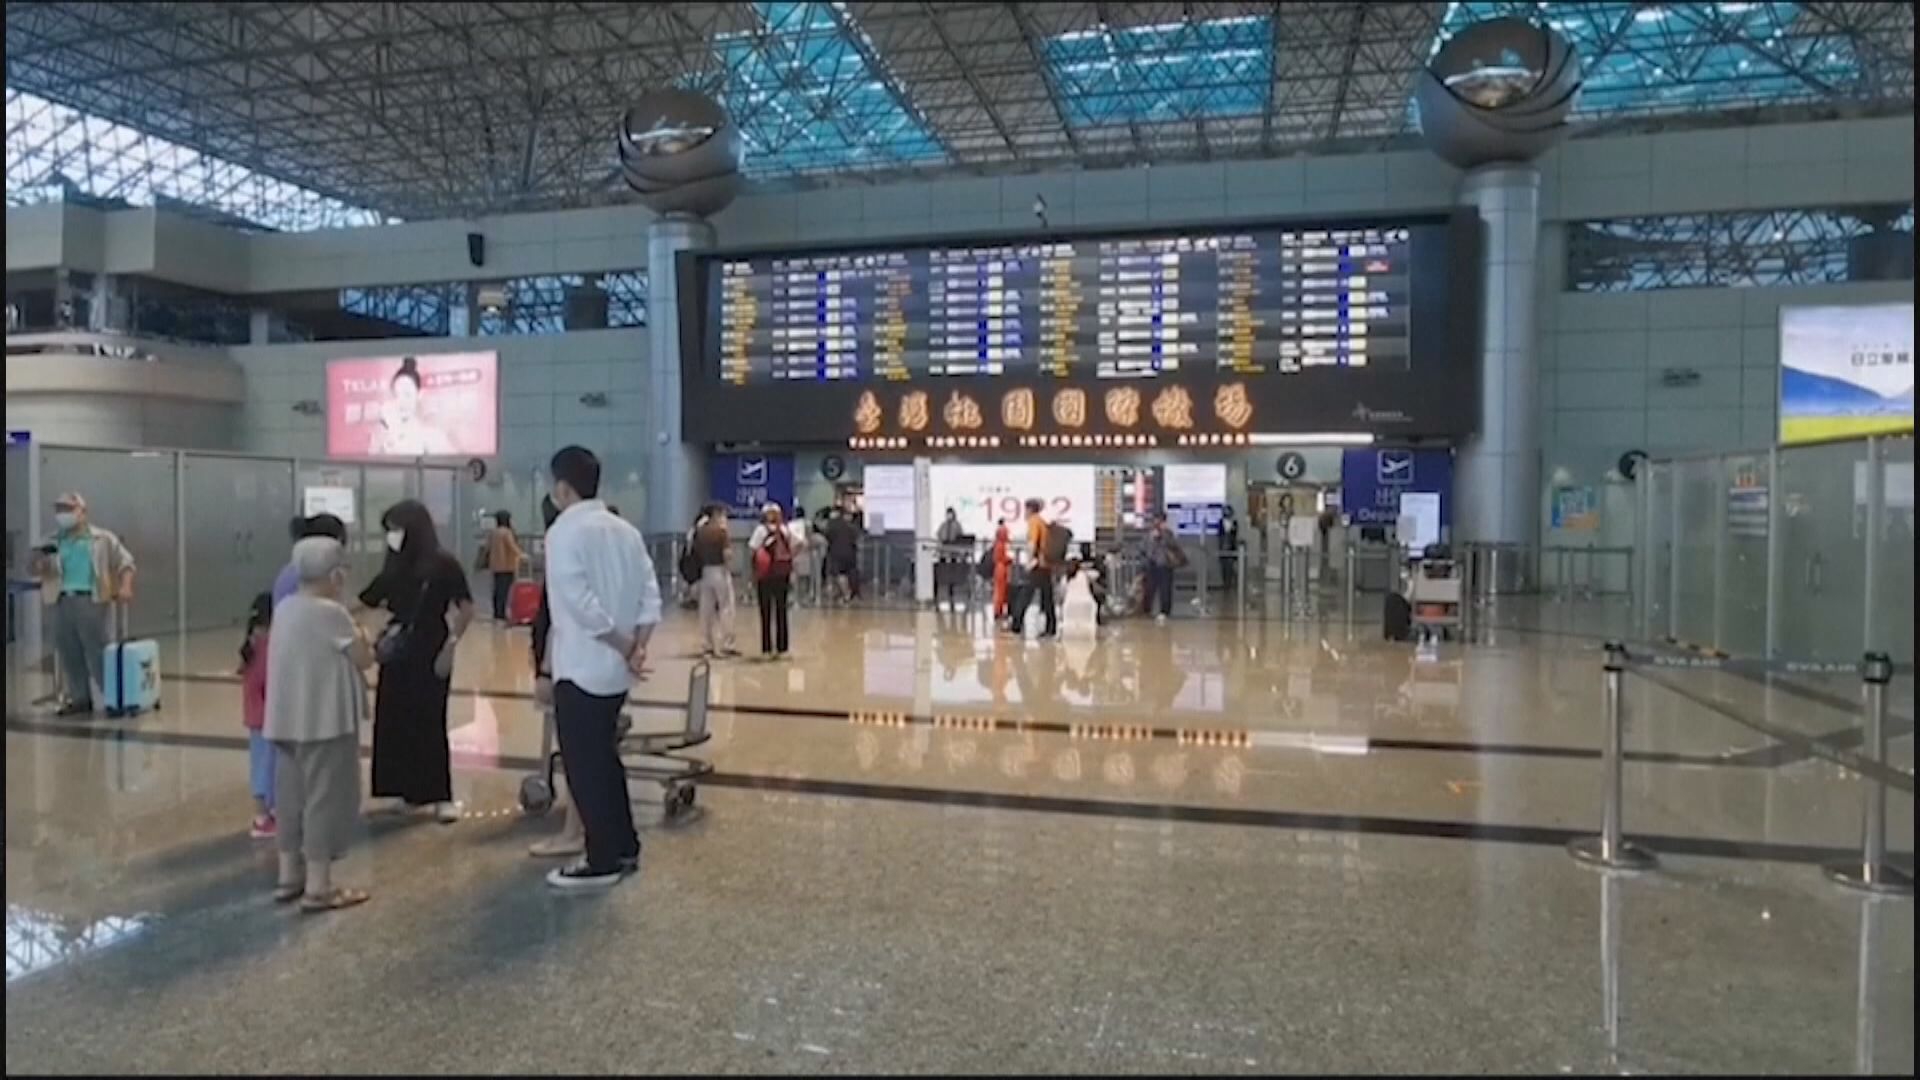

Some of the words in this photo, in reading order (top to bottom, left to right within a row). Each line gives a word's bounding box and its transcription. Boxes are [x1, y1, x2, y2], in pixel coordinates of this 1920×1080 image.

[848, 435, 908, 449] TAIWAN
[926, 435, 1000, 449] TAOYUAN
[1018, 434, 1158, 448] INTERNATIONAL
[1178, 433, 1256, 447] AIRPORT
[1284, 455, 1299, 475] 6
